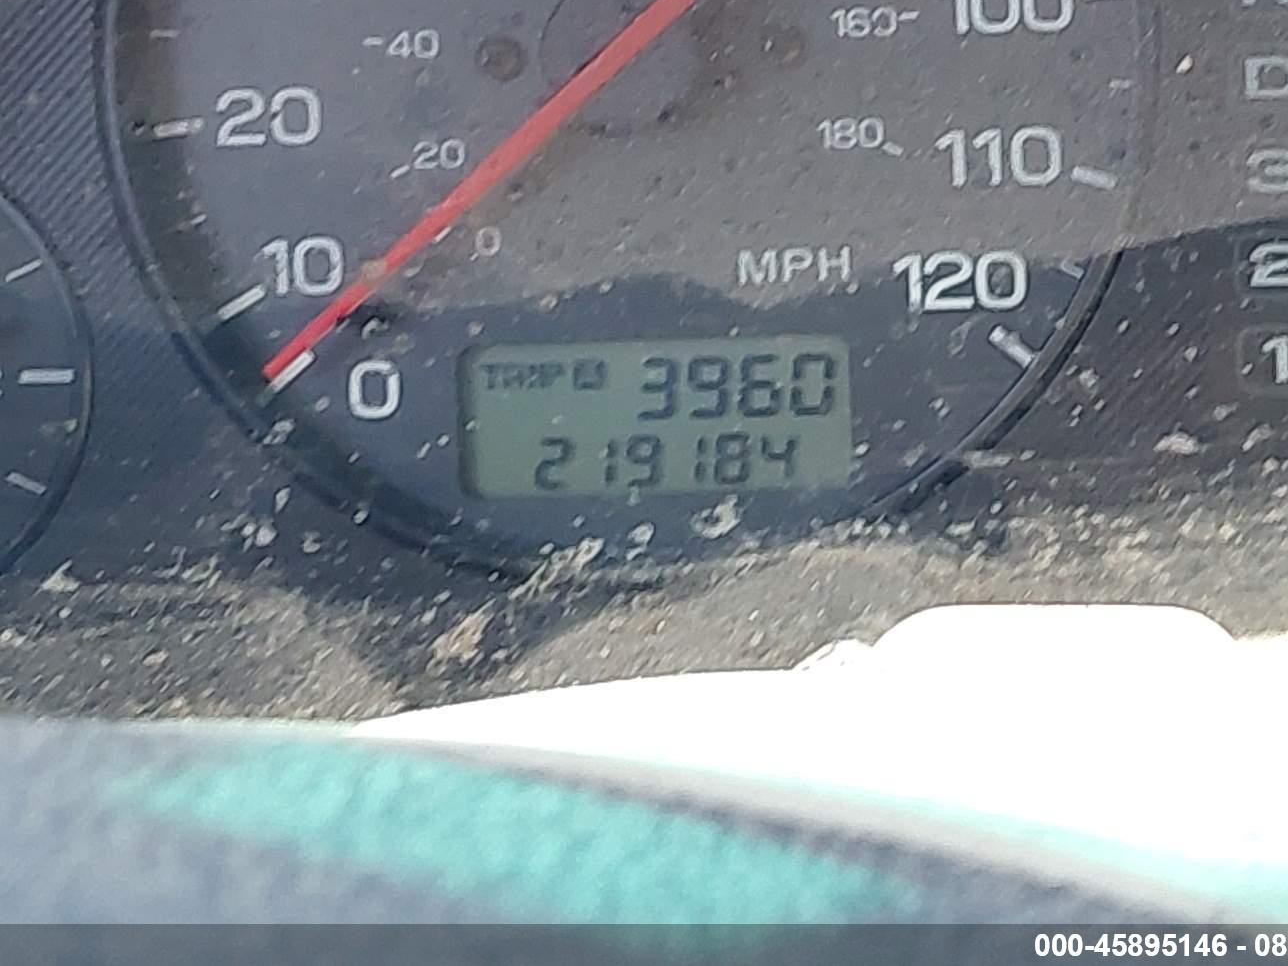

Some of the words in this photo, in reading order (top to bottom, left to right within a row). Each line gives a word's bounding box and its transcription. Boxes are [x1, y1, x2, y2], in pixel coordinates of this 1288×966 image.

[385, 30, 440, 60] 40
[830, 7, 898, 37] 160
[215, 86, 323, 147] 20
[816, 117, 884, 150] 180
[411, 140, 465, 170] 20
[934, 126, 1063, 187] 110
[261, 236, 345, 295] 10
[474, 227, 500, 255] 0
[736, 246, 852, 286] MPH
[893, 251, 1028, 312] 120
[348, 360, 401, 419] 0
[637, 353, 835, 421] 3960
[535, 432, 796, 490] 219184
